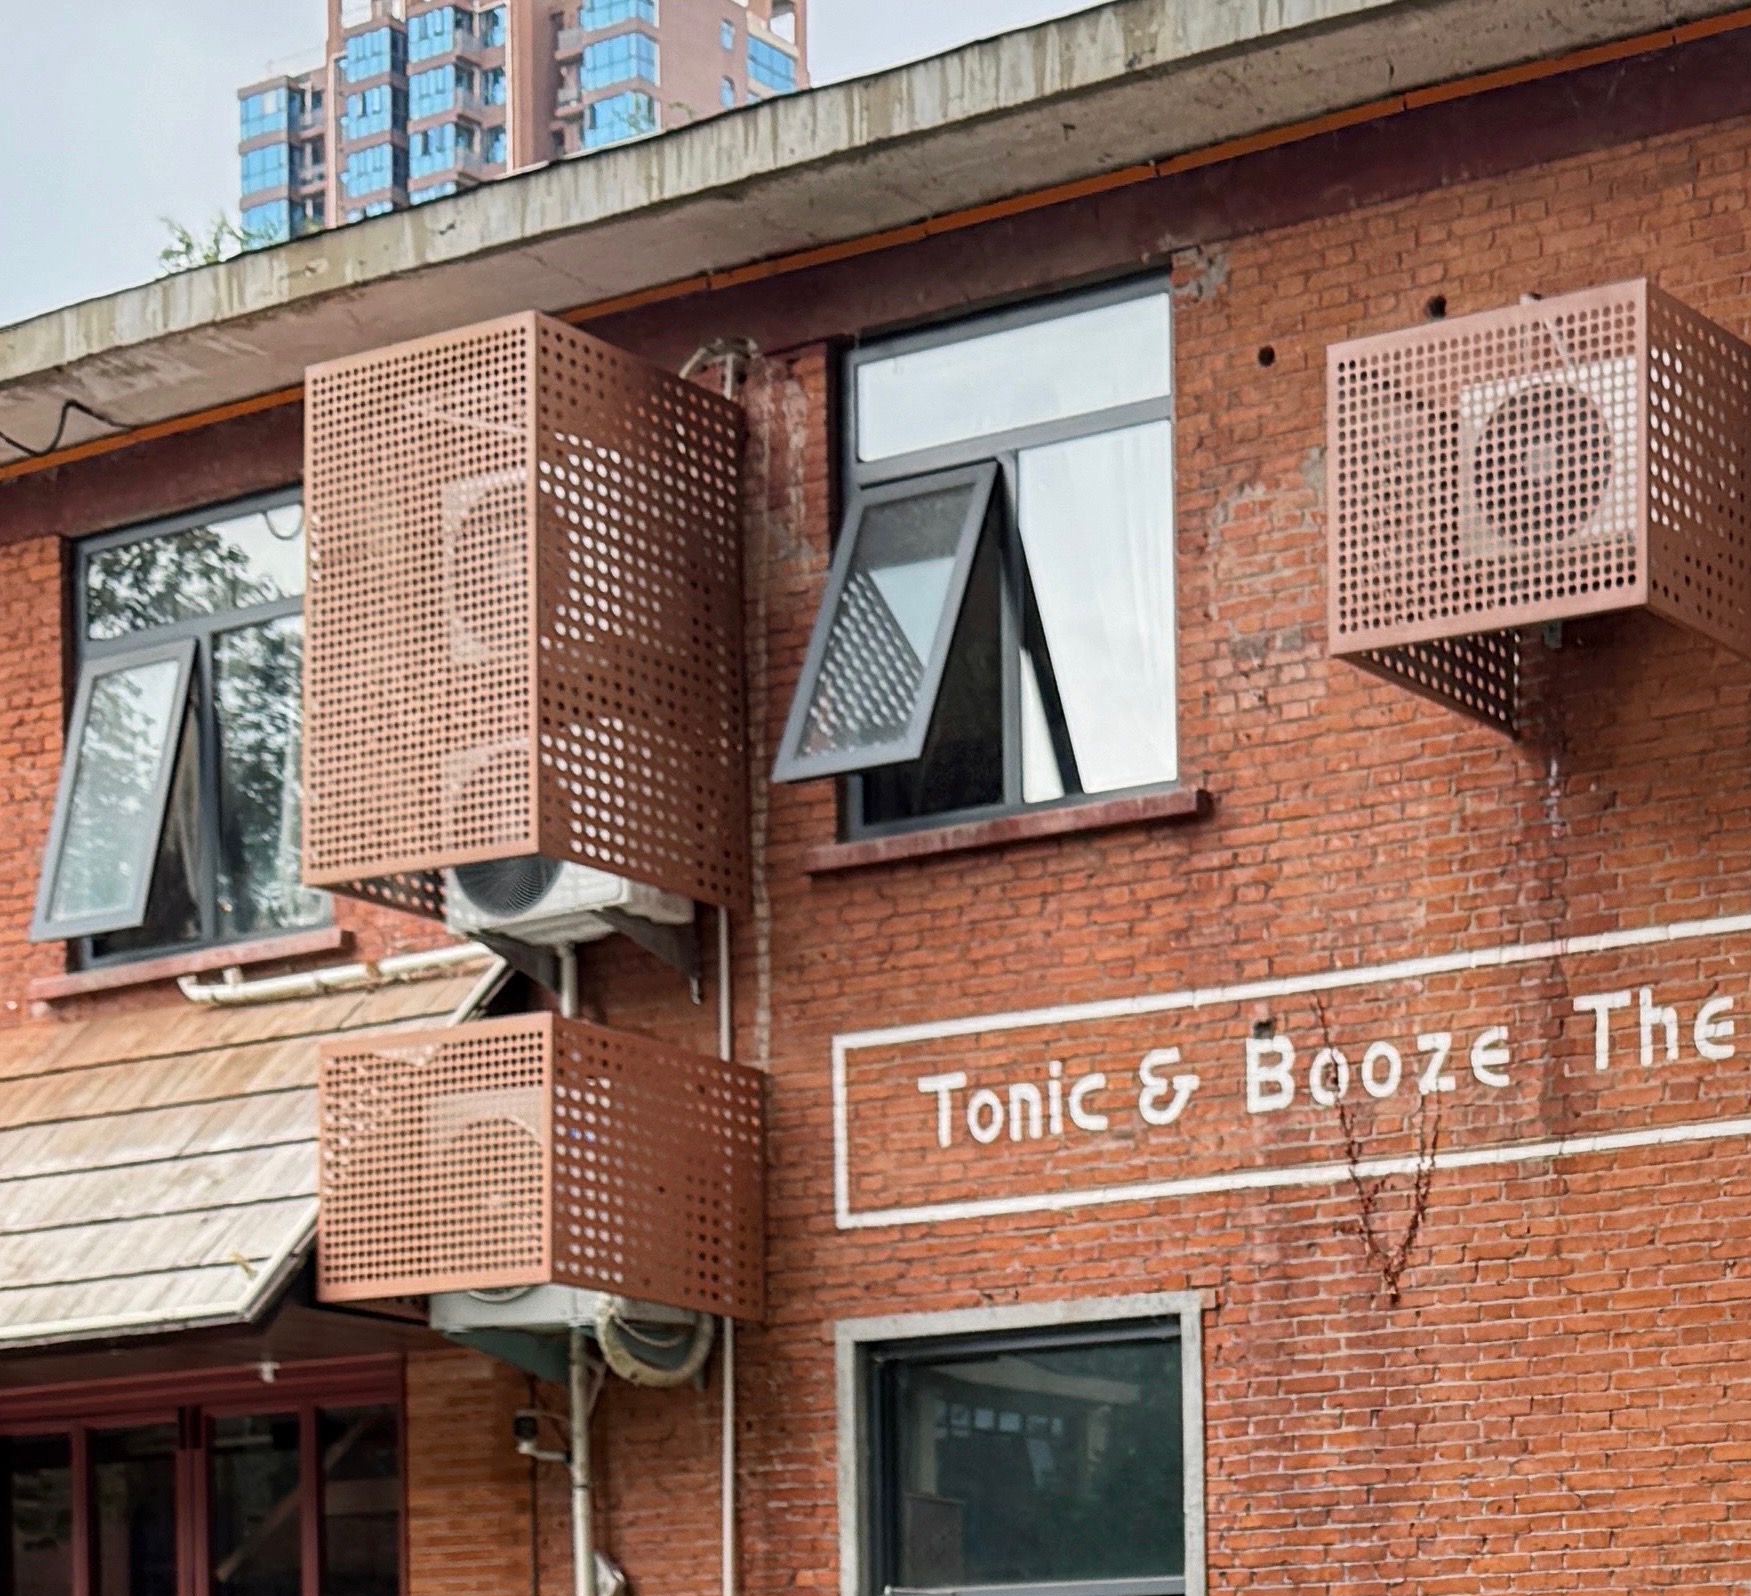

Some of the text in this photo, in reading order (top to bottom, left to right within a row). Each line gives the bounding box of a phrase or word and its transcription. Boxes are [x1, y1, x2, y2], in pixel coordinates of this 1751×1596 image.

[917, 1064, 1108, 1148] Tonic
[1138, 1046, 1201, 1125] &
[1244, 1025, 1511, 1114] Booze
[1573, 986, 1736, 1073] The
